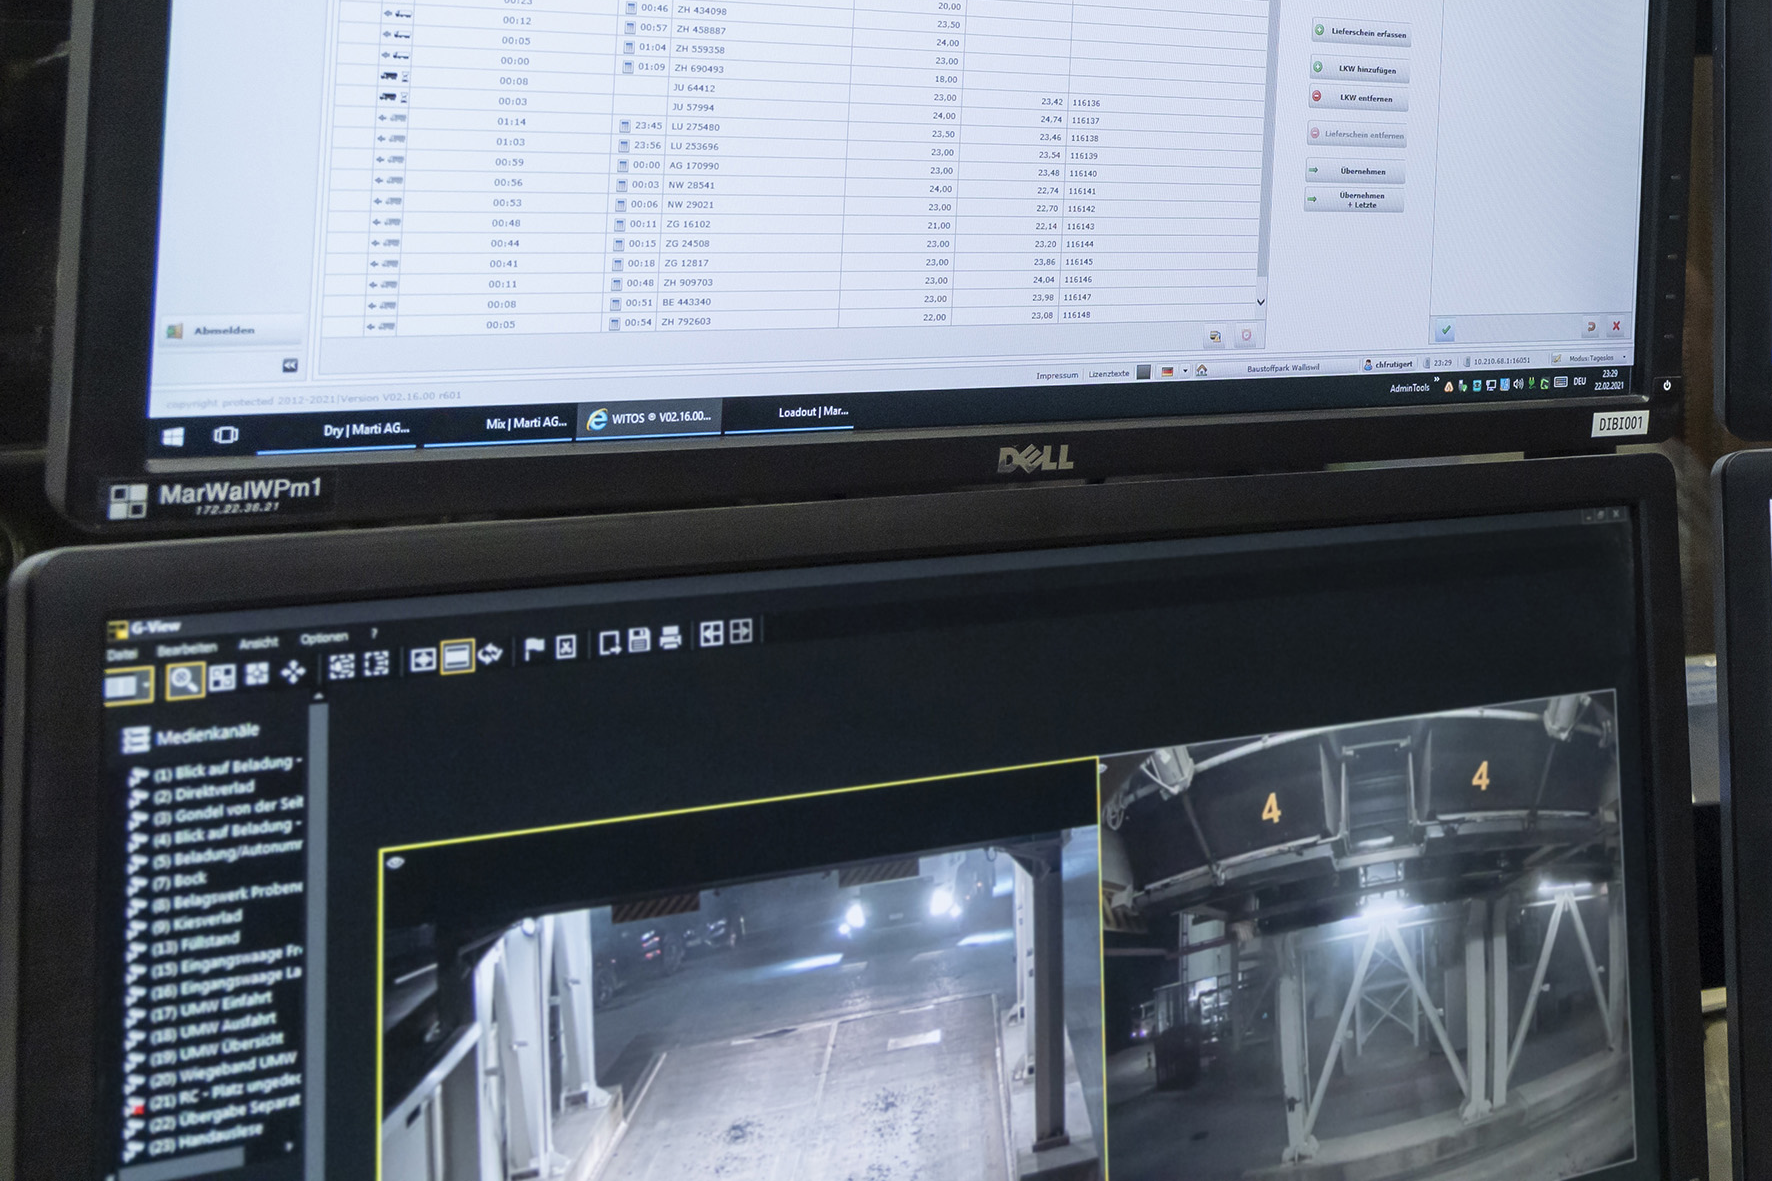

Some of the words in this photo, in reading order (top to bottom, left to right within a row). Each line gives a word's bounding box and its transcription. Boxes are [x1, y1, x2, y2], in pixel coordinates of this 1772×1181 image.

[1332, 27, 1375, 38] Lieferschein
[1377, 30, 1407, 40] erfassen
[1339, 65, 1355, 74] LKW
[1357, 65, 1397, 76] hinzufügen
[1073, 99, 1101, 107] 116136
[1340, 94, 1356, 102] LKW
[1358, 95, 1393, 104] entfernen
[671, 123, 683, 131] LU
[686, 123, 720, 132] 275480
[1341, 166, 1386, 176] Übernehmen
[1339, 190, 1385, 200] Übernehmen
[1355, 200, 1377, 209] Letzte
[661, 318, 675, 326] ZH
[678, 317, 712, 326] 792603
[194, 325, 255, 336] Abmelden
[1036, 370, 1079, 382] Impressum
[1088, 368, 1130, 380] Lizenztexte
[1247, 364, 1293, 375] Baustoffpark
[1602, 369, 1618, 378] 23:29
[1390, 382, 1430, 395] AdminTools
[1573, 377, 1587, 387] DEU
[1594, 381, 1625, 391] 22.02.2021
[612, 412, 645, 426] WITOS
[778, 406, 817, 419] Loadout
[323, 424, 344, 439] Dry
[353, 422, 381, 436] Marti
[1599, 415, 1643, 433] DIBI001
[997, 443, 1075, 475] DELL
[159, 477, 322, 506] MarWalWPm1
[131, 620, 181, 635] G-View
[239, 636, 279, 651] Ansicht
[300, 630, 349, 646] Optionen
[156, 722, 260, 746] Medienkanäle
[1472, 761, 1490, 790] 4
[1262, 793, 1281, 824] 4
